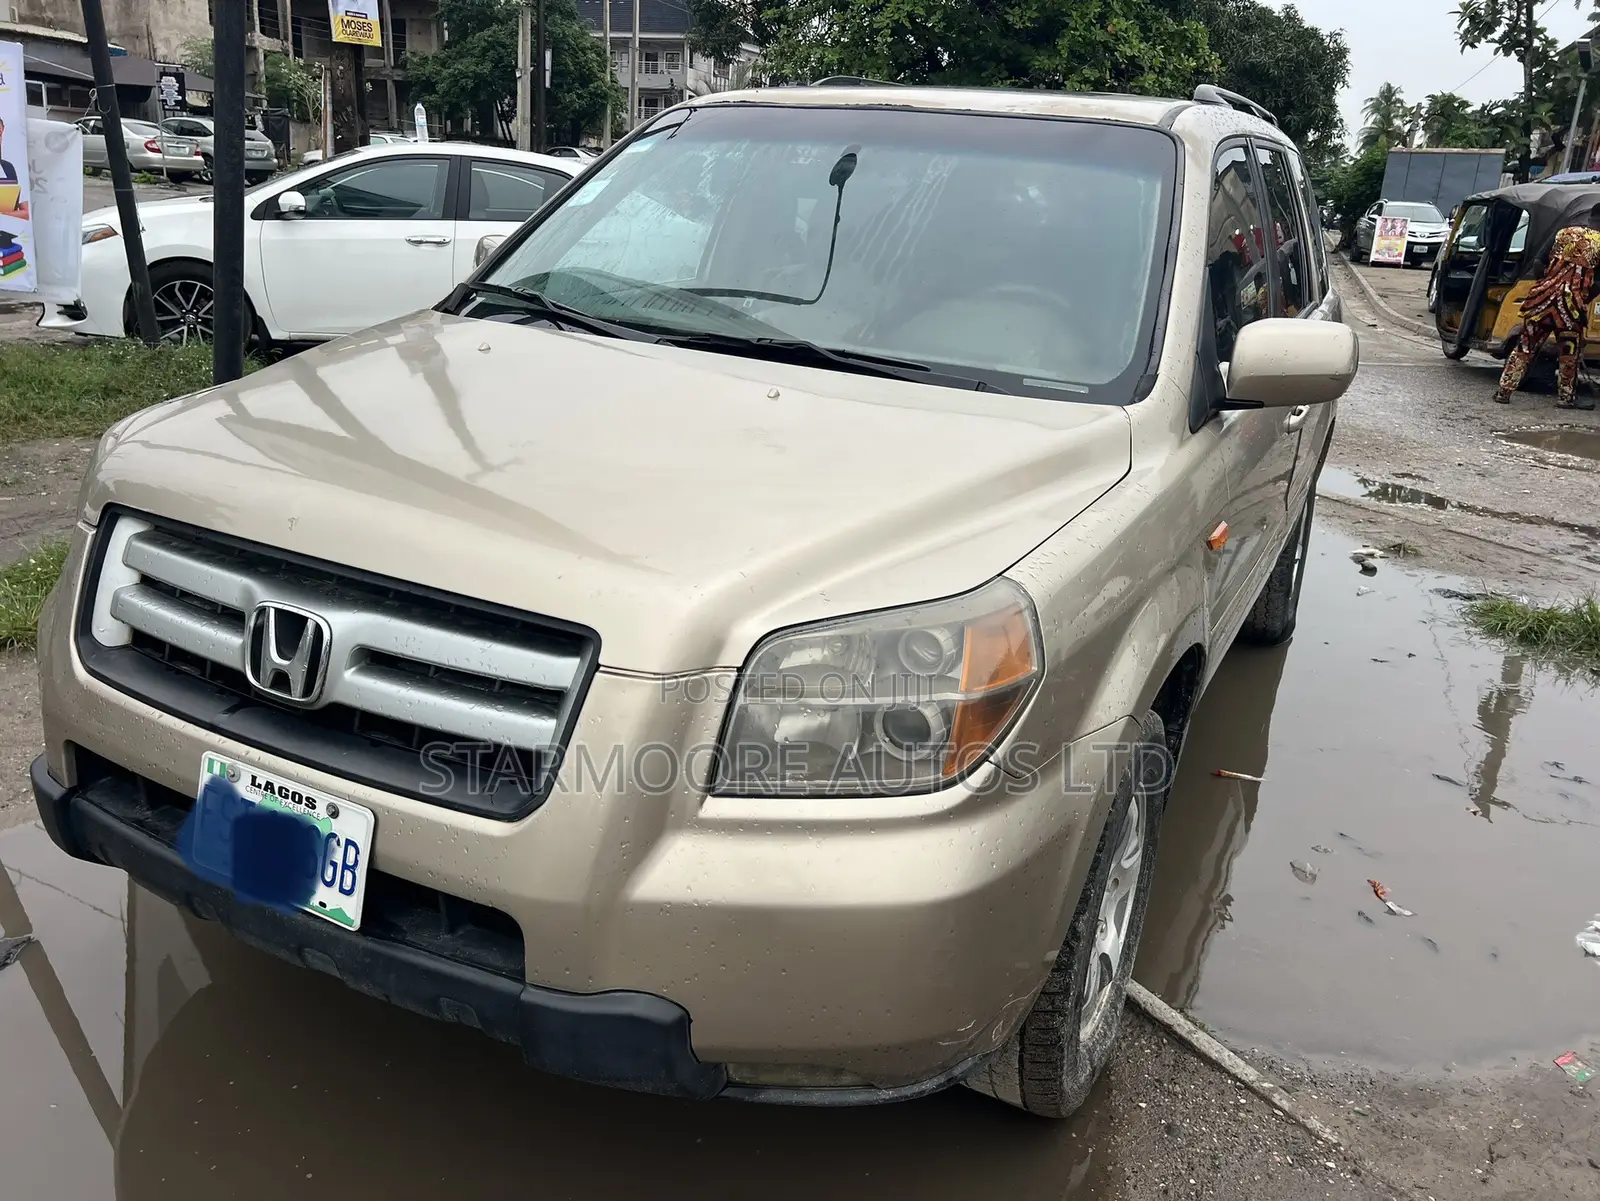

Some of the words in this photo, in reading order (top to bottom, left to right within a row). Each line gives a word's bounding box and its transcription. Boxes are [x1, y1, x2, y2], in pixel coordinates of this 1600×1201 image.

[341, 19, 373, 32] MOSES
[341, 29, 374, 39] OLAREWAJU
[245, 785, 269, 800] CENTRE
[269, 794, 280, 803] OF
[279, 798, 321, 819] EXCELLENCE
[250, 774, 317, 811] LAGOS
